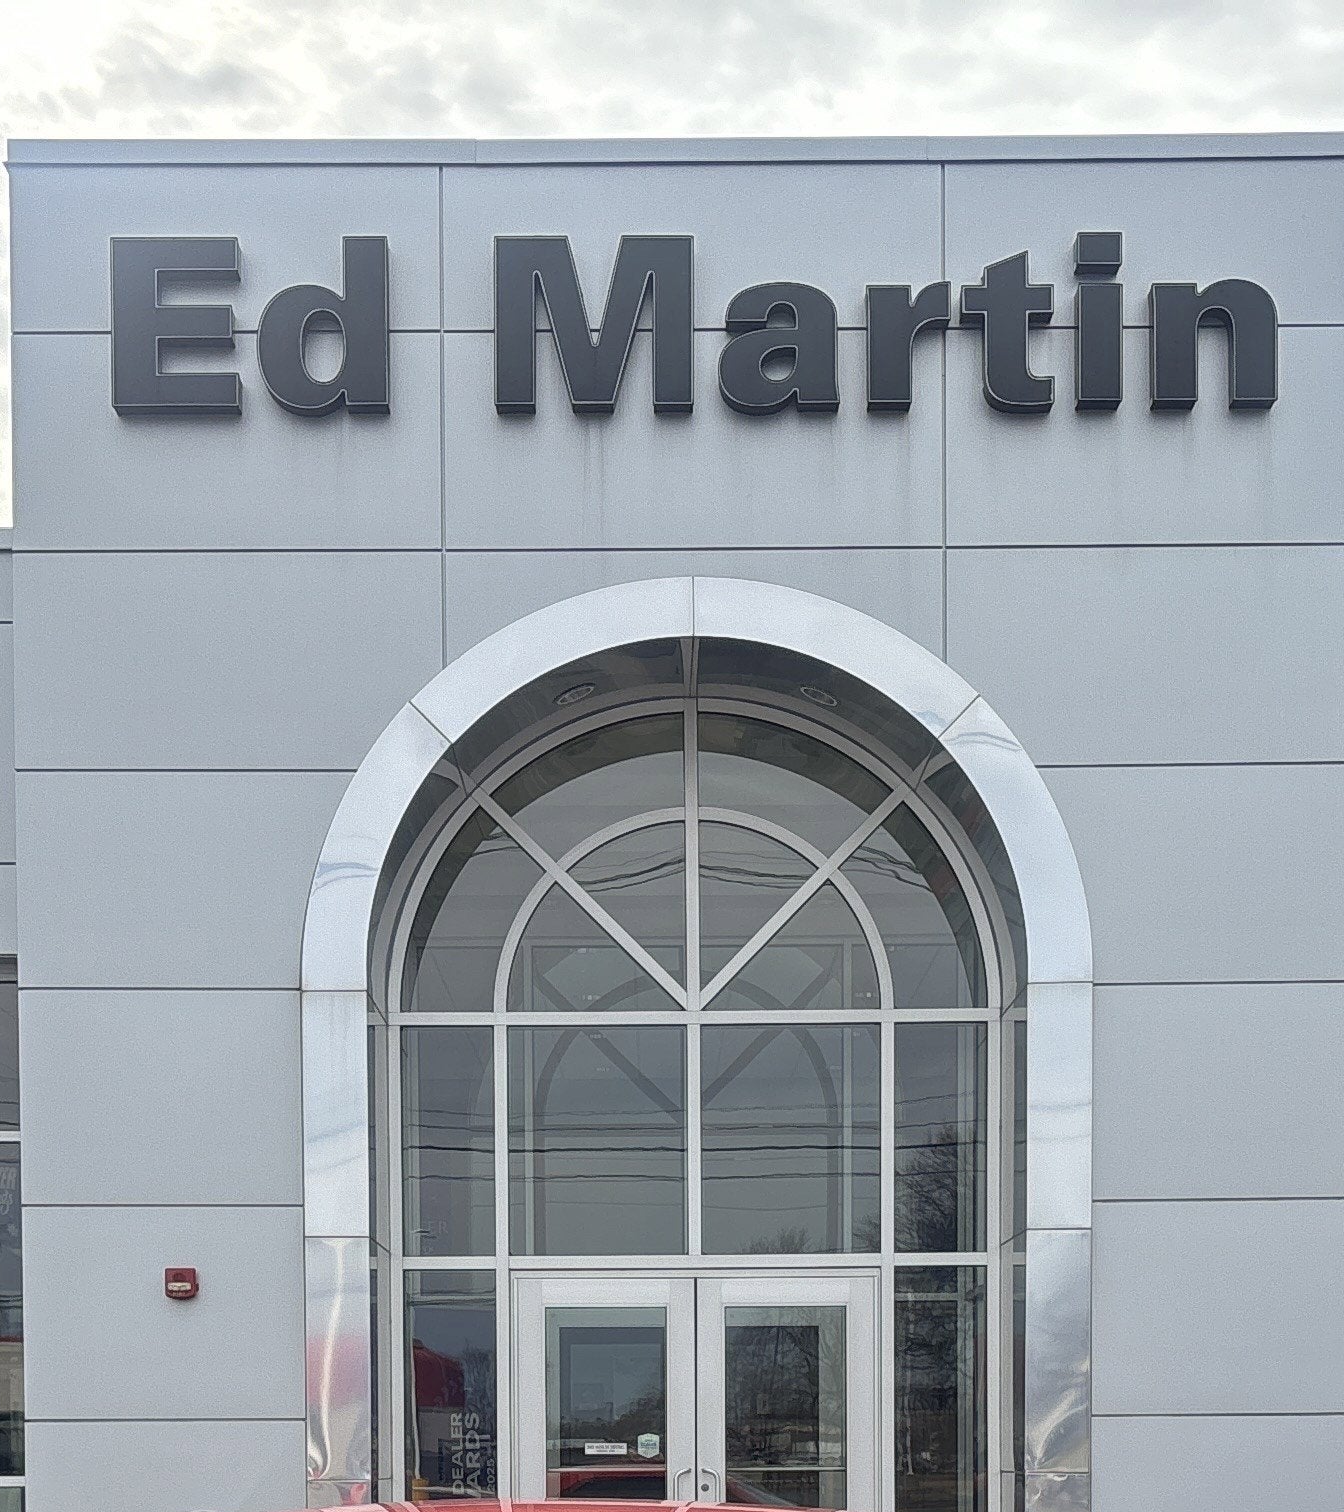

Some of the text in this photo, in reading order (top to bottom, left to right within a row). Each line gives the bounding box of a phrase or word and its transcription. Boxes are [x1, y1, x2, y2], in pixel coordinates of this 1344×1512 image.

[110, 230, 1278, 418] Ed Martin
[450, 1412, 465, 1495] DEALER
